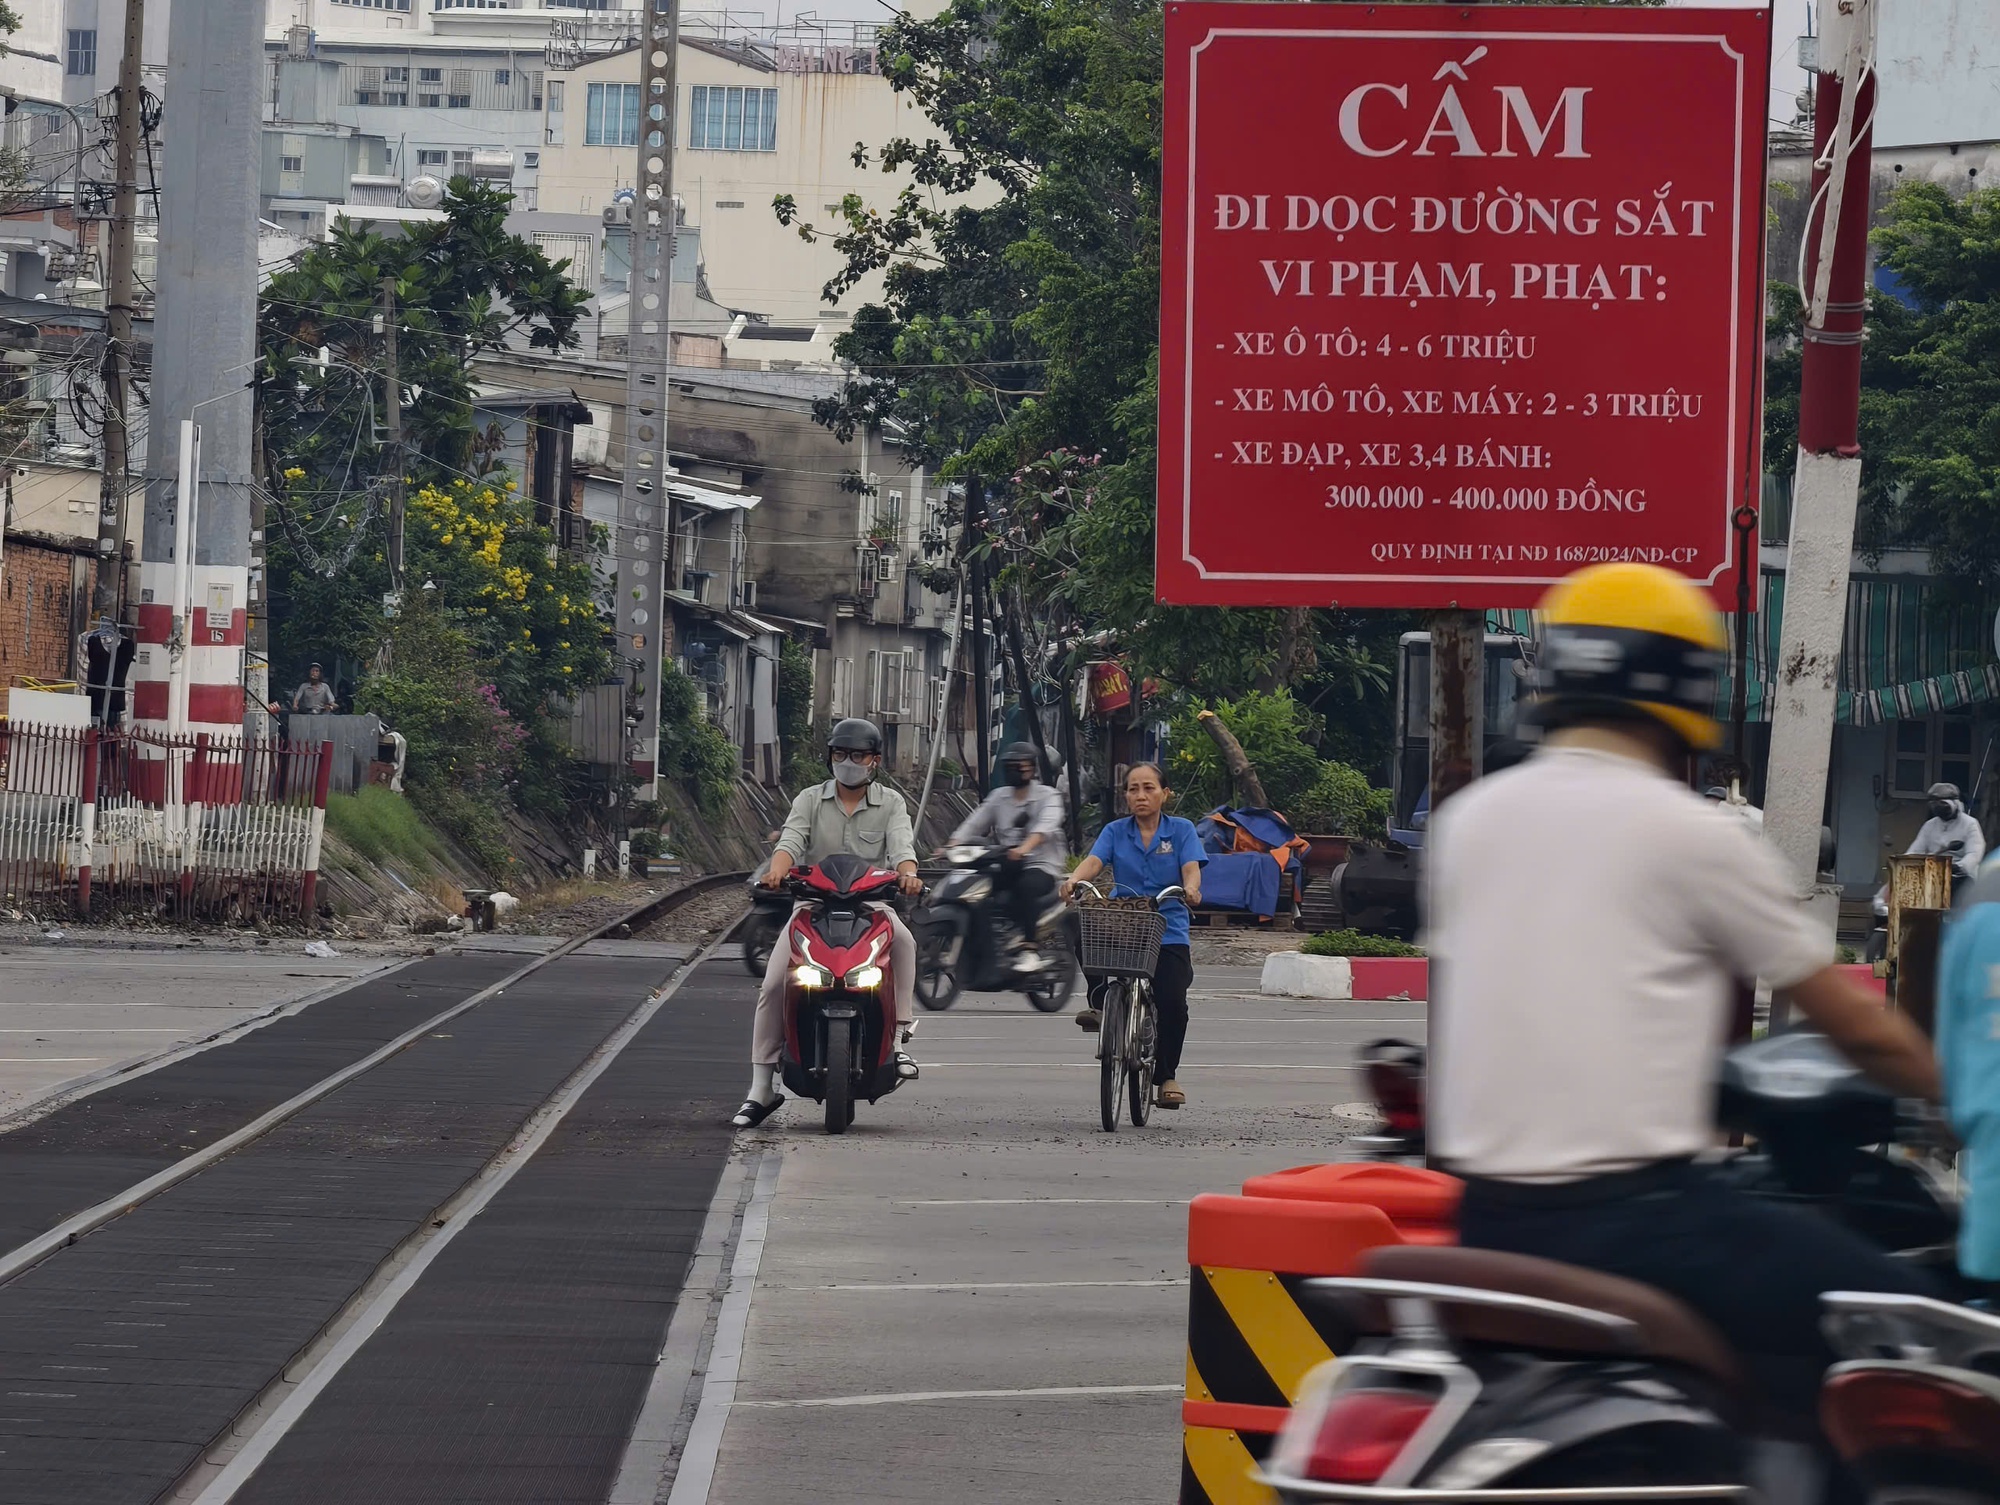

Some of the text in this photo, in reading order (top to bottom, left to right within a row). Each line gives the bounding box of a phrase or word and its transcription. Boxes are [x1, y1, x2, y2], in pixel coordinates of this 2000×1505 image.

[1338, 45, 1593, 158] CẤM
[1214, 181, 1714, 242] ĐI DỌC ĐƯỜNG SẮT
[1260, 260, 1667, 311] VI PHẠM, PHẠT:
[1233, 331, 1275, 357] XE
[1284, 326, 1307, 357] Ô
[1315, 326, 1368, 358] TÔ:
[1376, 334, 1392, 357] 4
[1417, 334, 1432, 357] 6
[1440, 329, 1536, 365] TRIỆU
[1233, 388, 1275, 412] XE
[1283, 382, 1335, 413] MÔ
[1343, 383, 1394, 418] TÔ,
[1402, 391, 1444, 414] XE
[1453, 385, 1533, 416] MÁY:
[1542, 392, 1557, 415] 2
[1583, 393, 1598, 416] 3
[1606, 387, 1702, 423] TRIỆU
[1232, 441, 1274, 465] XE
[1281, 442, 1352, 471] ĐẠP,
[1360, 443, 1402, 467] XE
[1409, 443, 1448, 471] 3,4
[1455, 437, 1552, 469] BÁNH:
[1324, 485, 1424, 509] 300.000
[1449, 487, 1549, 511] 400.000
[1556, 477, 1647, 513] ĐỒNG
[1371, 543, 1699, 565] QUY ĐỊNH TẠI NĐ 168/2024/NĐ-CP
